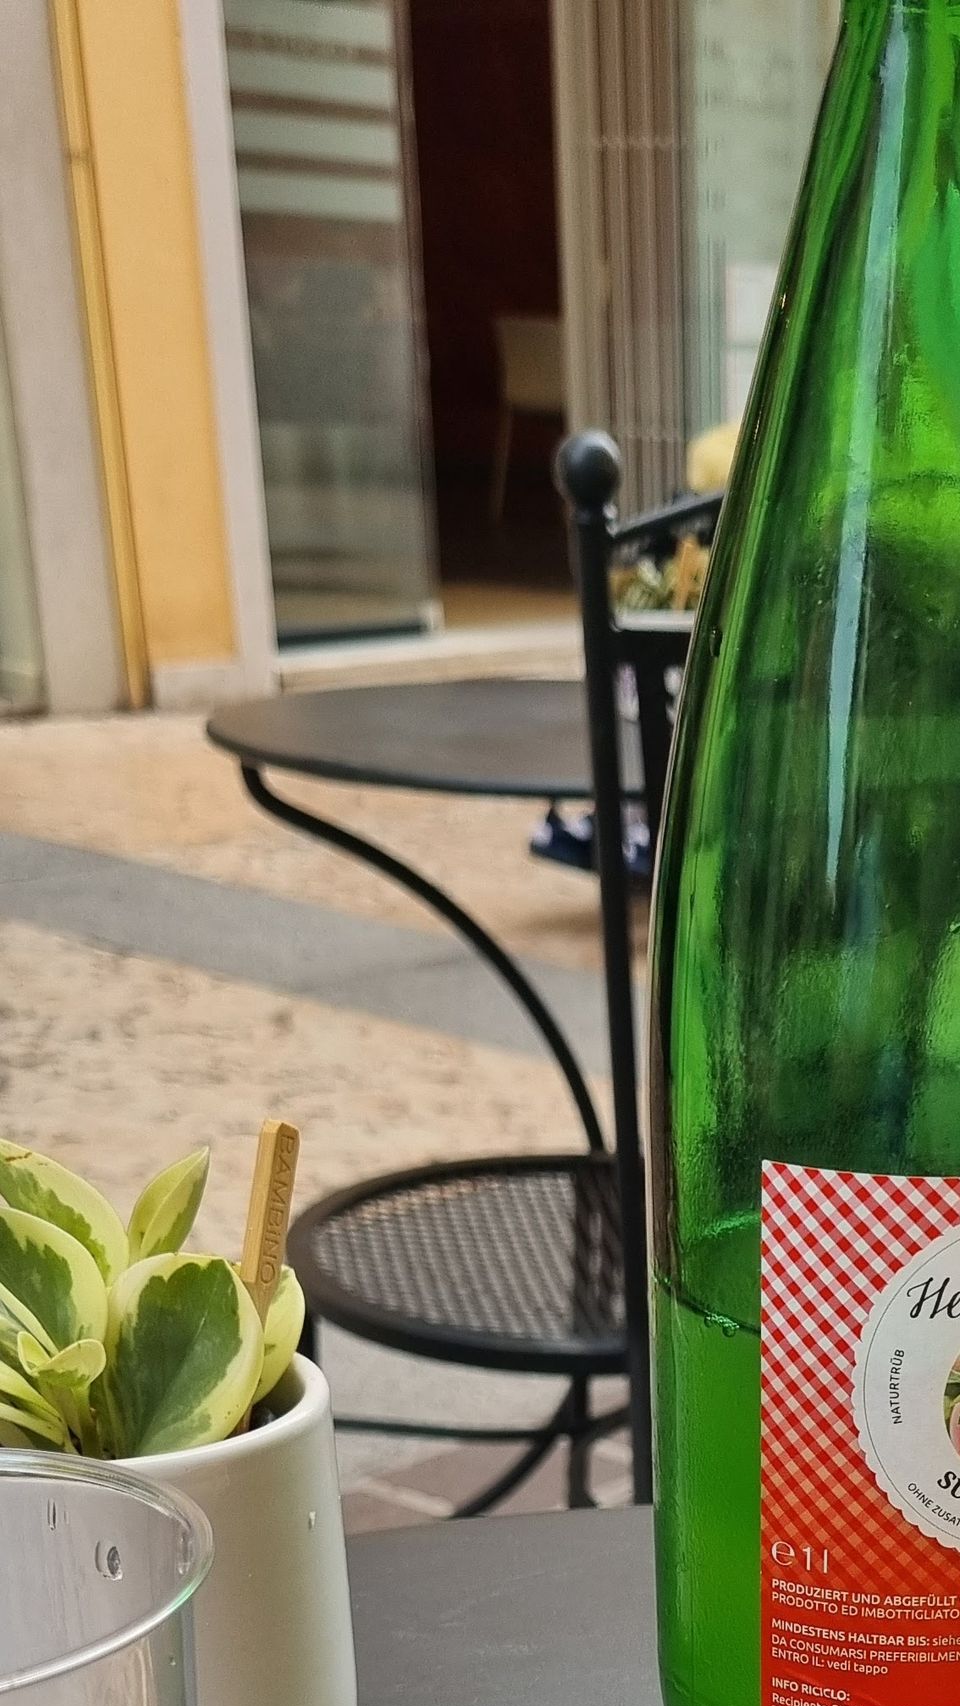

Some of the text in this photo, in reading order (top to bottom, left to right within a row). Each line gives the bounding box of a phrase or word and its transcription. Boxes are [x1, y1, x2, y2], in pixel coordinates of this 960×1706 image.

[889, 1349, 905, 1424] NATURTRÜB
[907, 1483, 934, 1508] OHNE
[772, 1578, 849, 1602] PRODUZIERT
[852, 1593, 880, 1605] UND
[884, 1594, 957, 1607] ABGEFÜLLT
[772, 1591, 838, 1614] PRODOTTO
[841, 1605, 858, 1616] ED
[861, 1607, 960, 1620] IMBOTTIGLIATO
[771, 1618, 846, 1641] MINDESTENS
[848, 1632, 904, 1646] HALTBAR
[907, 1636, 930, 1646] BIS:
[771, 1634, 787, 1647] DA
[789, 1639, 866, 1659] CONSUMARSI
[771, 1647, 888, 1675] ENTRO IL: vedi tappo
[772, 1677, 851, 1701] INFO RICICLO:
